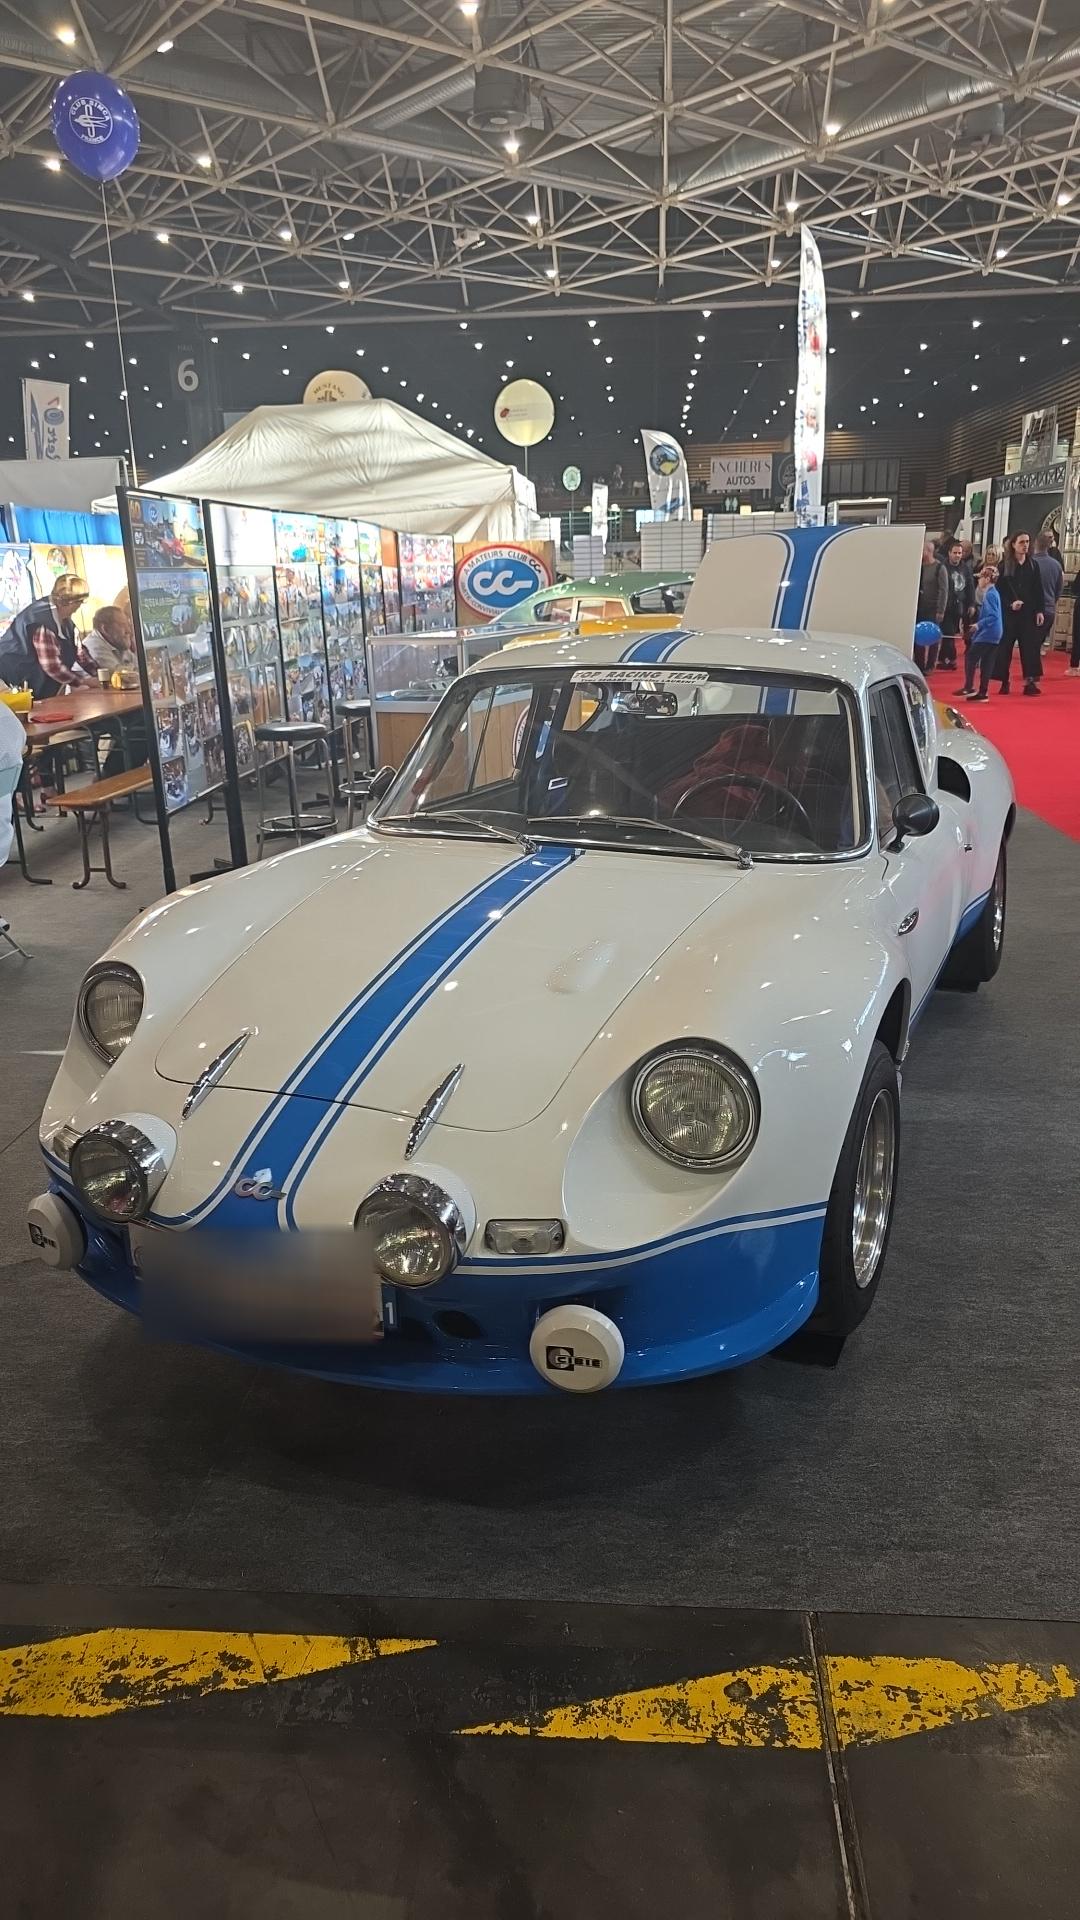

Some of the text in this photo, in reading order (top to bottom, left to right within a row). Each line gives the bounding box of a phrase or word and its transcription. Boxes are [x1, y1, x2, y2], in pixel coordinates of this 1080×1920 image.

[71, 99, 110, 121] CLUB SIMCA
[177, 358, 199, 392] 6
[726, 475, 756, 486] AUTOS
[463, 550, 504, 576] AMATEURS
[507, 550, 528, 562] CLUB
[605, 671, 661, 679] RACING
[667, 672, 709, 681] TEAM
[556, 1354, 602, 1369] CIBIE
